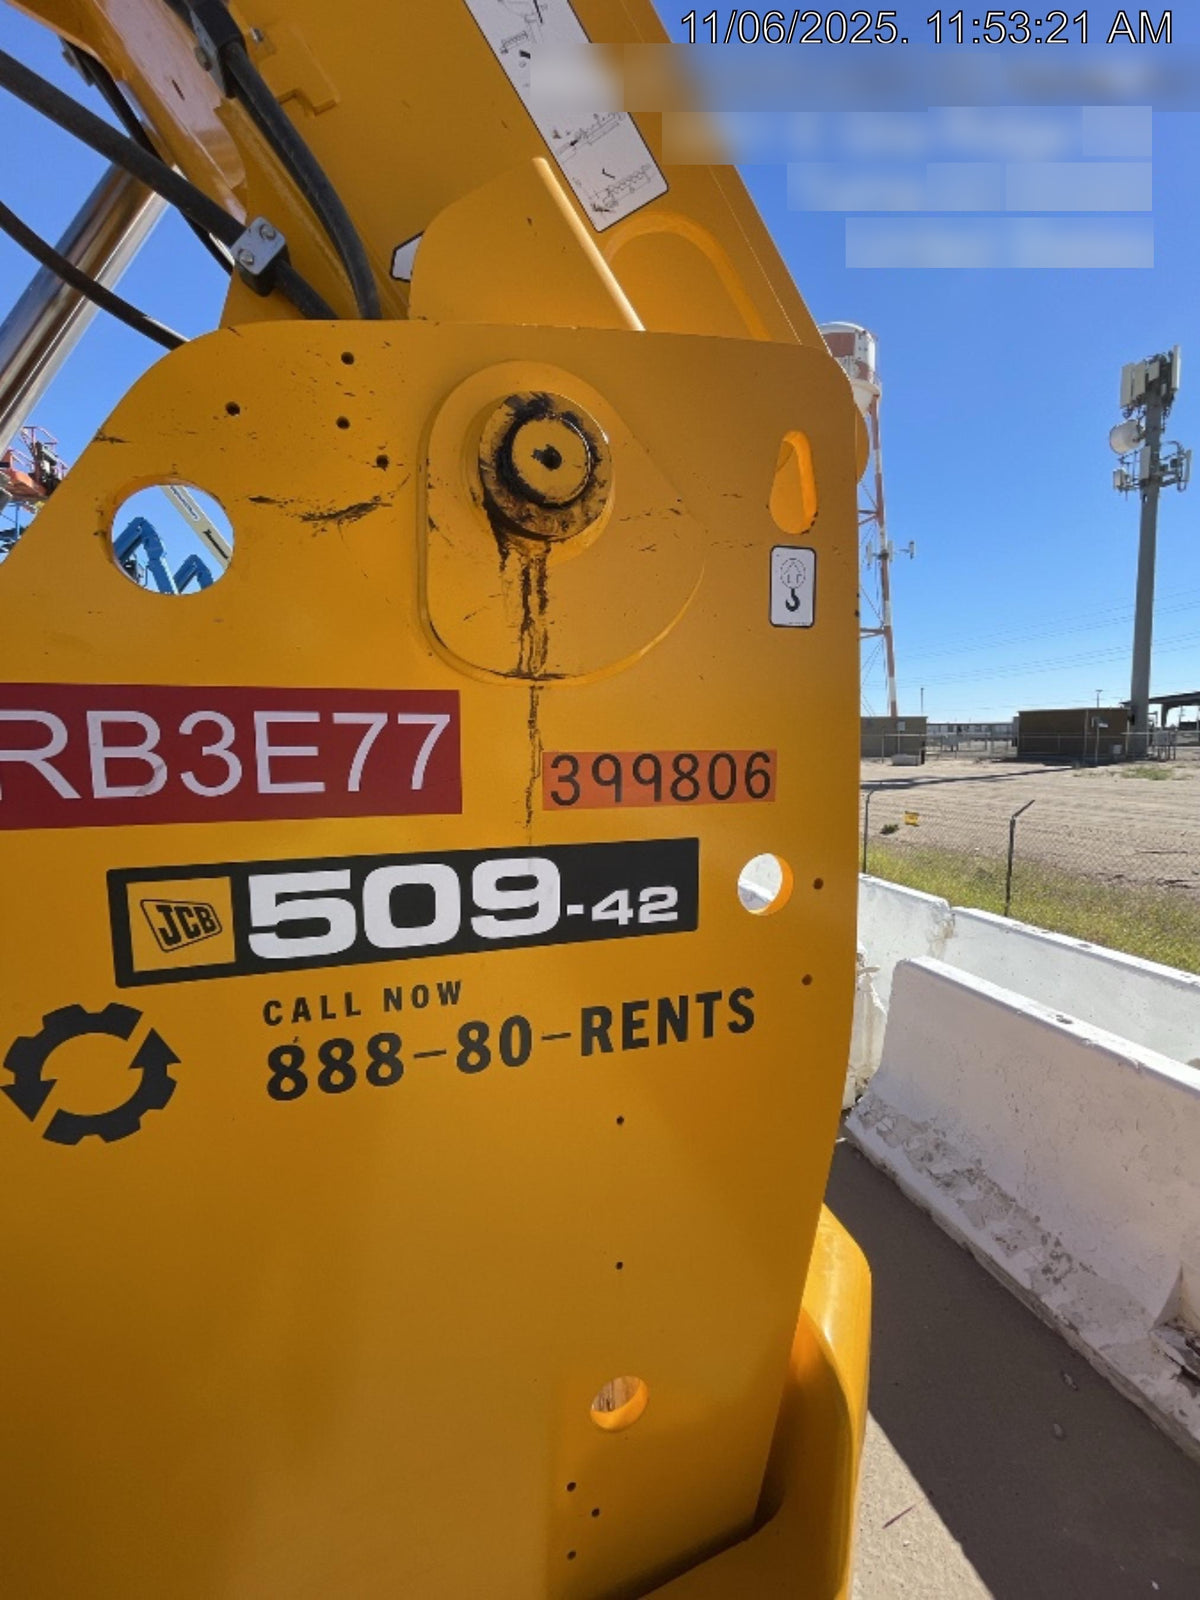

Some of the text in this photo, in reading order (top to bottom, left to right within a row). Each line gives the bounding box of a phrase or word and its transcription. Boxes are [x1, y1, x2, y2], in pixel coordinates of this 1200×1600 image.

[0, 710, 451, 799] RB3E77
[550, 751, 772, 806] 399806
[156, 904, 217, 946] JCB
[248, 856, 679, 959] 509-42
[263, 979, 463, 1027] CALL NOW
[266, 986, 756, 1101] 888-80-RENTS
